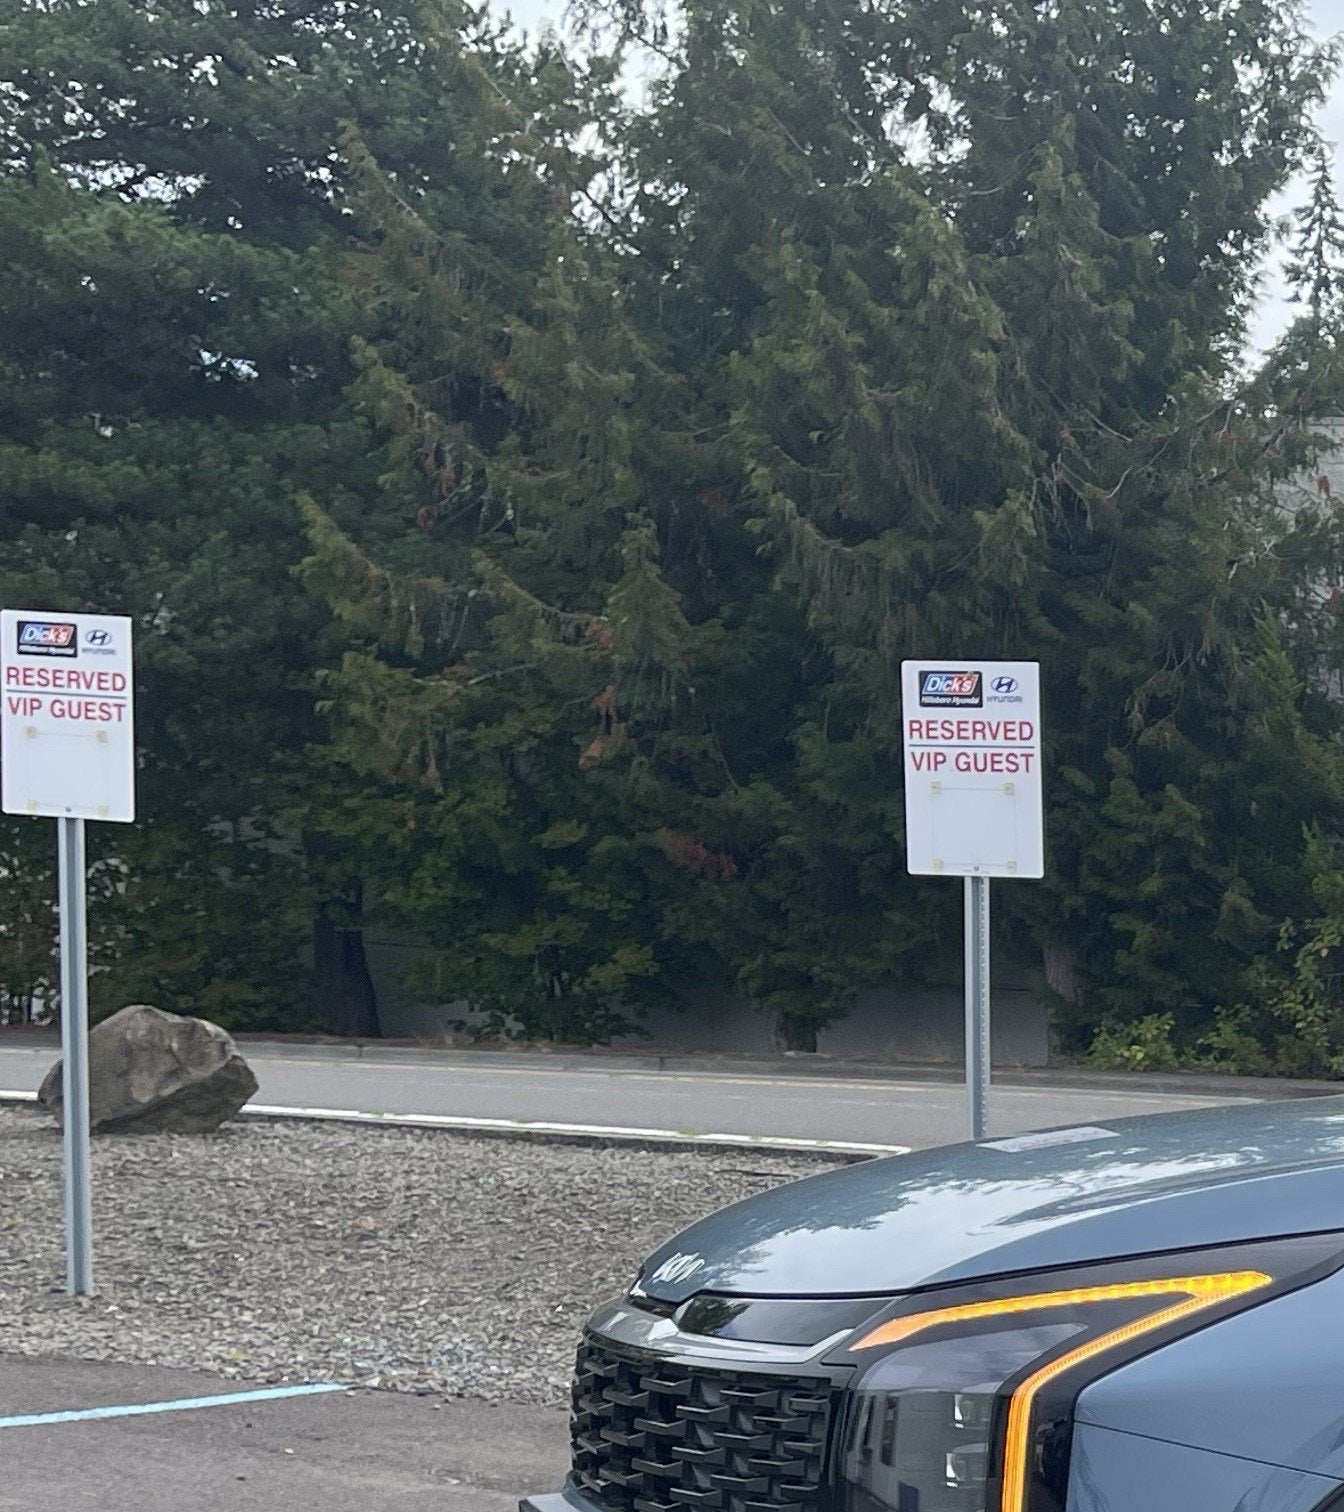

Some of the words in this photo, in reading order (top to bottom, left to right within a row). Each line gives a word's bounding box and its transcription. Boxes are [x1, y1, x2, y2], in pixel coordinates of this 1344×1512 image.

[6, 666, 126, 692] RESERVED
[7, 696, 42, 717] VIP
[50, 699, 126, 722] GUEST
[908, 719, 1034, 742] RESERVED
[910, 751, 947, 772] VIP
[955, 752, 1035, 773] GUEST
